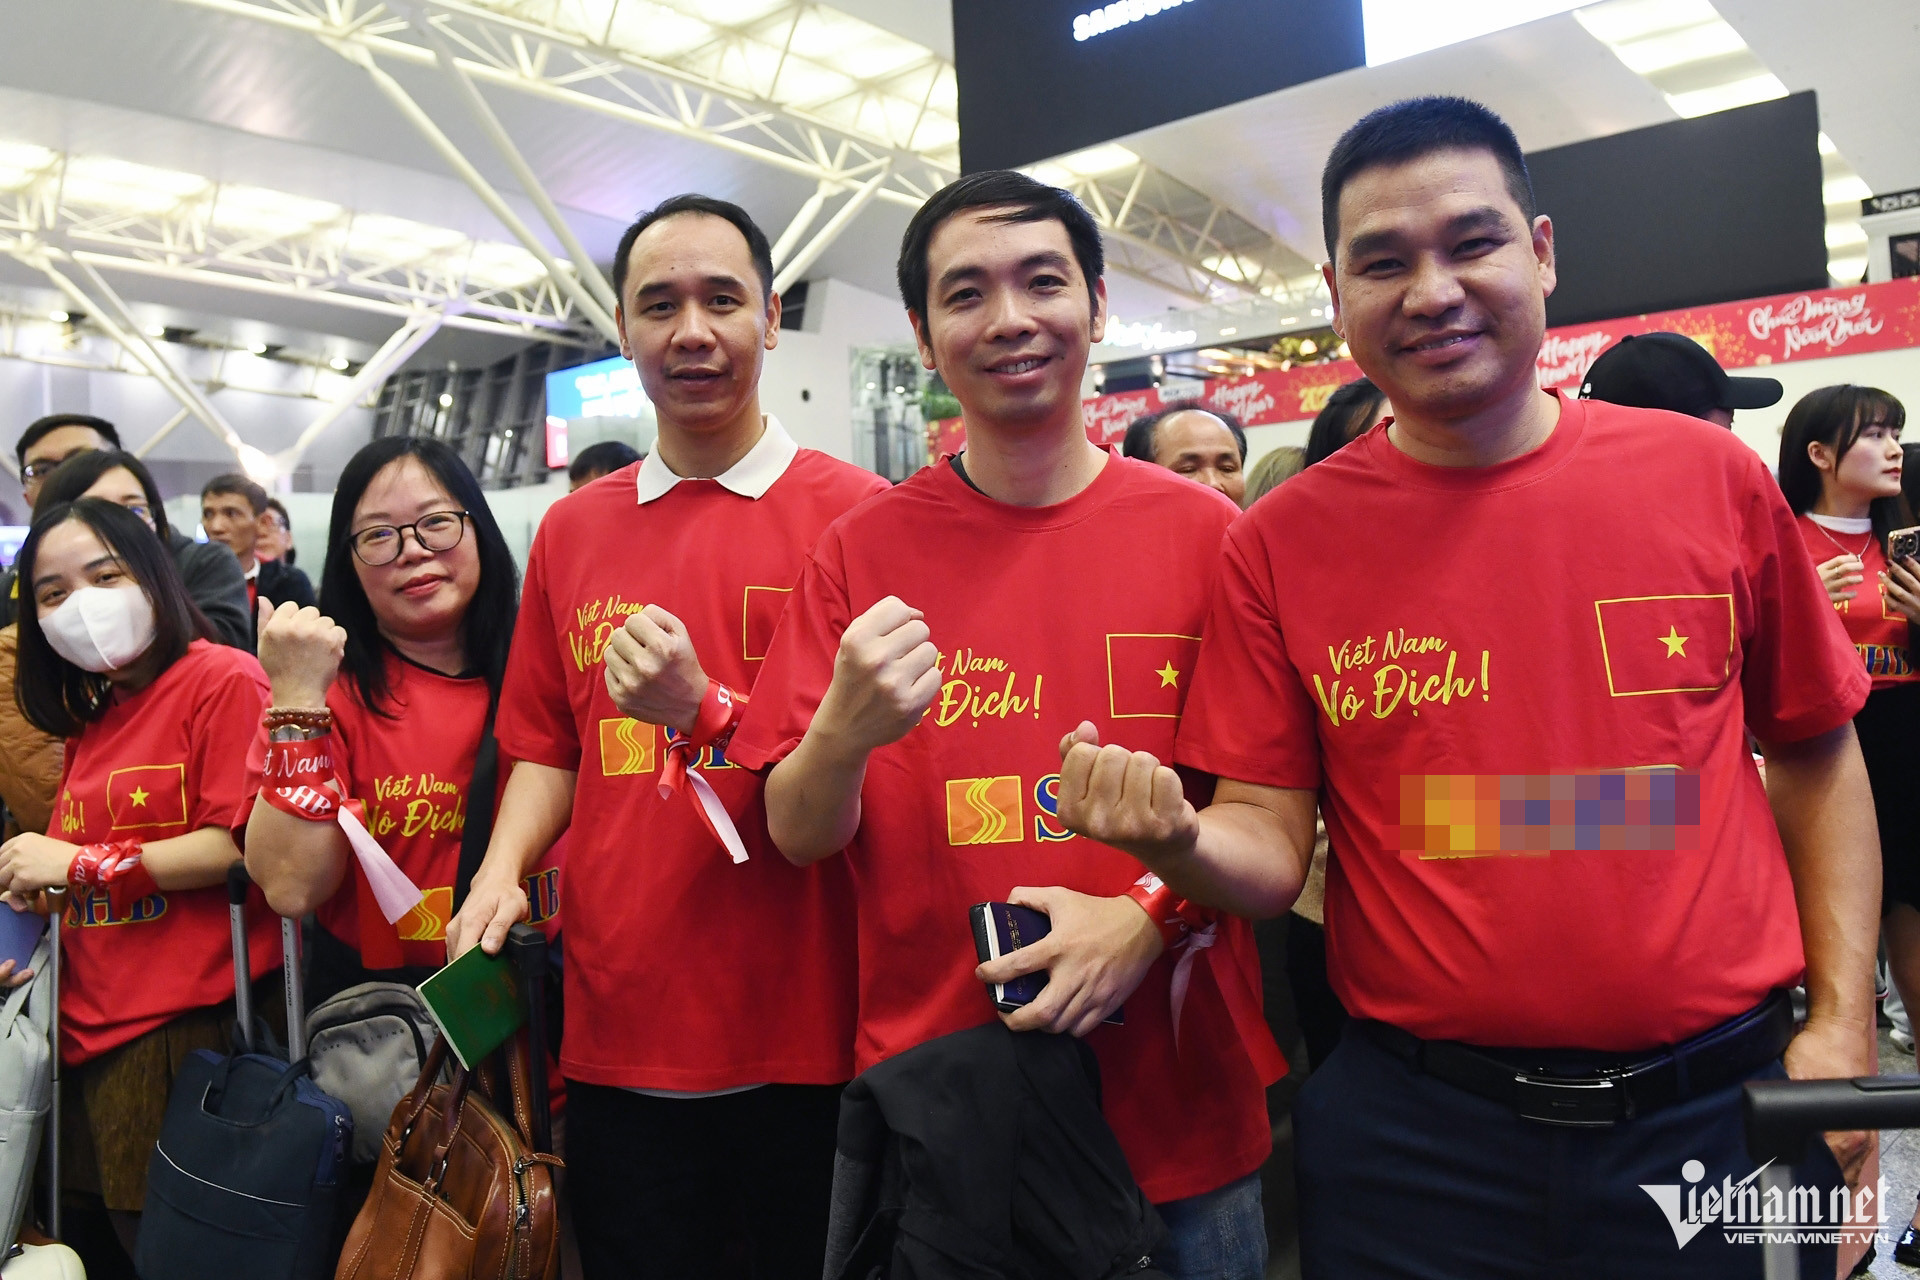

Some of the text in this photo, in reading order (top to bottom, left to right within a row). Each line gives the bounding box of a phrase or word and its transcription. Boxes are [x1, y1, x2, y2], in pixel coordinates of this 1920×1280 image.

[1073, 0, 1196, 41] SAMSU
[602, 594, 644, 620] Nam
[950, 647, 1008, 676] Nam
[1328, 627, 1448, 675] Việt Nam
[1854, 643, 1914, 677] HB
[1312, 673, 1365, 728] Vô
[277, 747, 333, 778] Nam
[374, 772, 459, 801] Việt Nam
[360, 797, 397, 838] Vô
